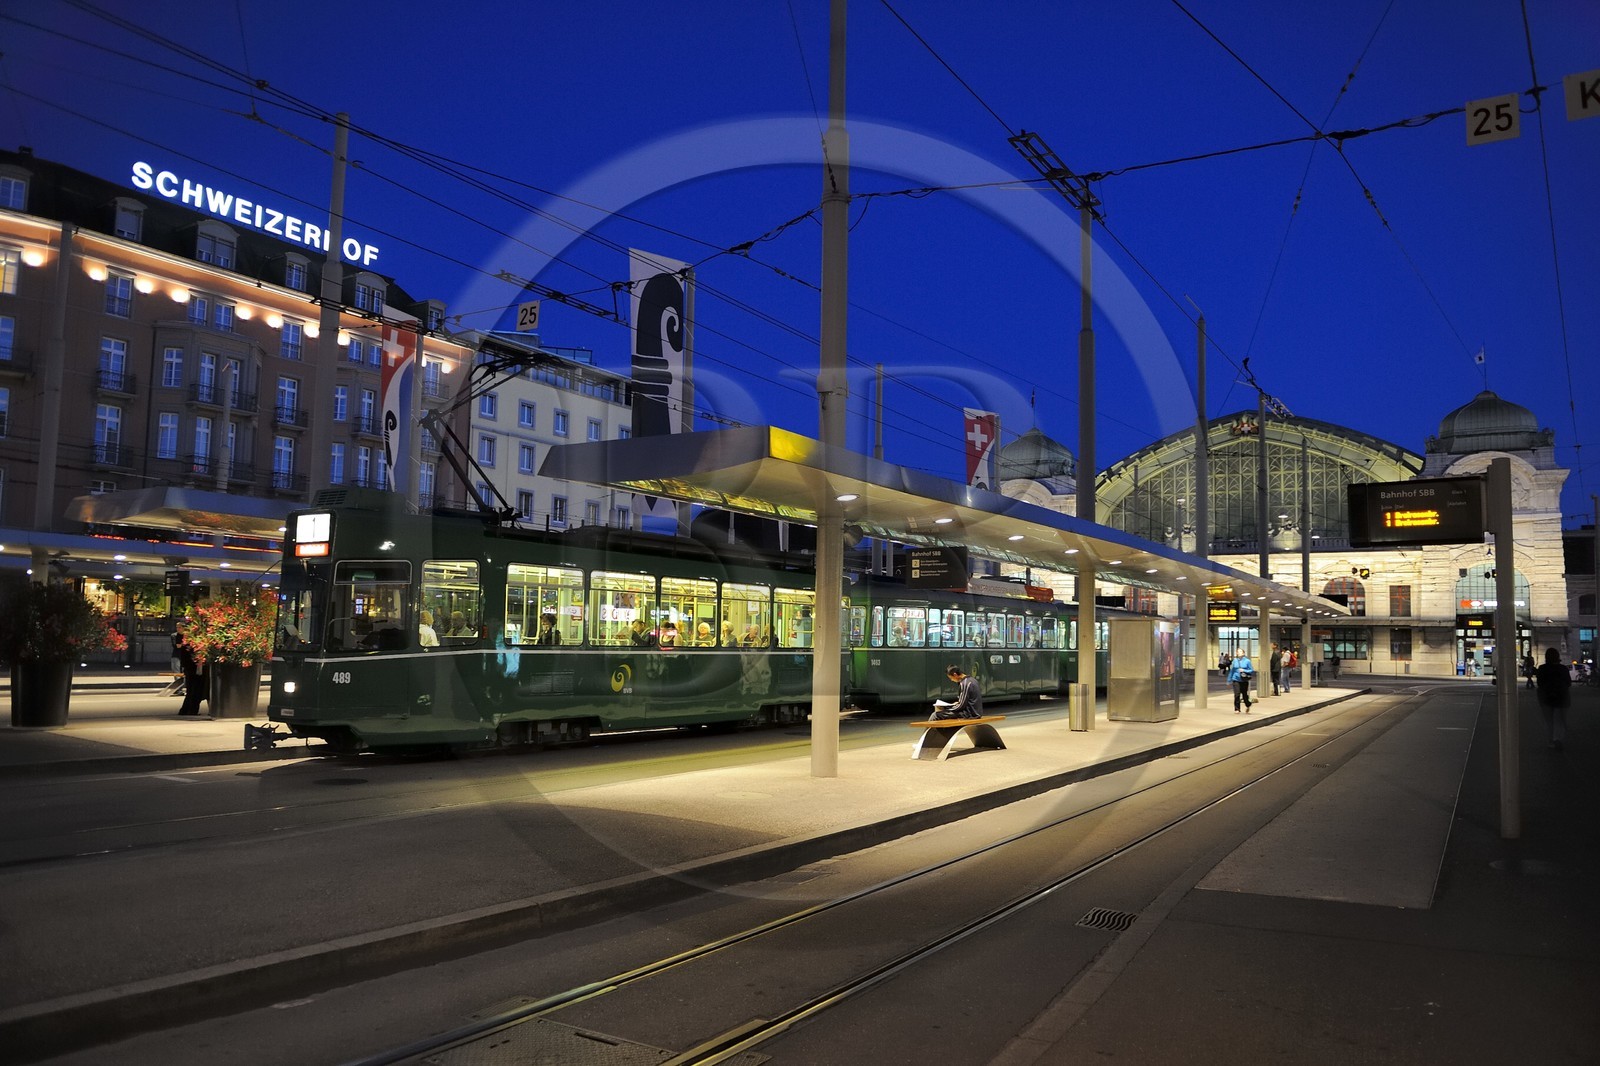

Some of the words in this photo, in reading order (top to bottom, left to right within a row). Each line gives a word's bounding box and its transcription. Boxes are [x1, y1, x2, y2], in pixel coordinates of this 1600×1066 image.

[1473, 103, 1513, 137] 25
[520, 306, 537, 325] 25
[1380, 489, 1416, 499] Bahnhof
[1419, 488, 1435, 497] SBB
[332, 672, 351, 684] 489
